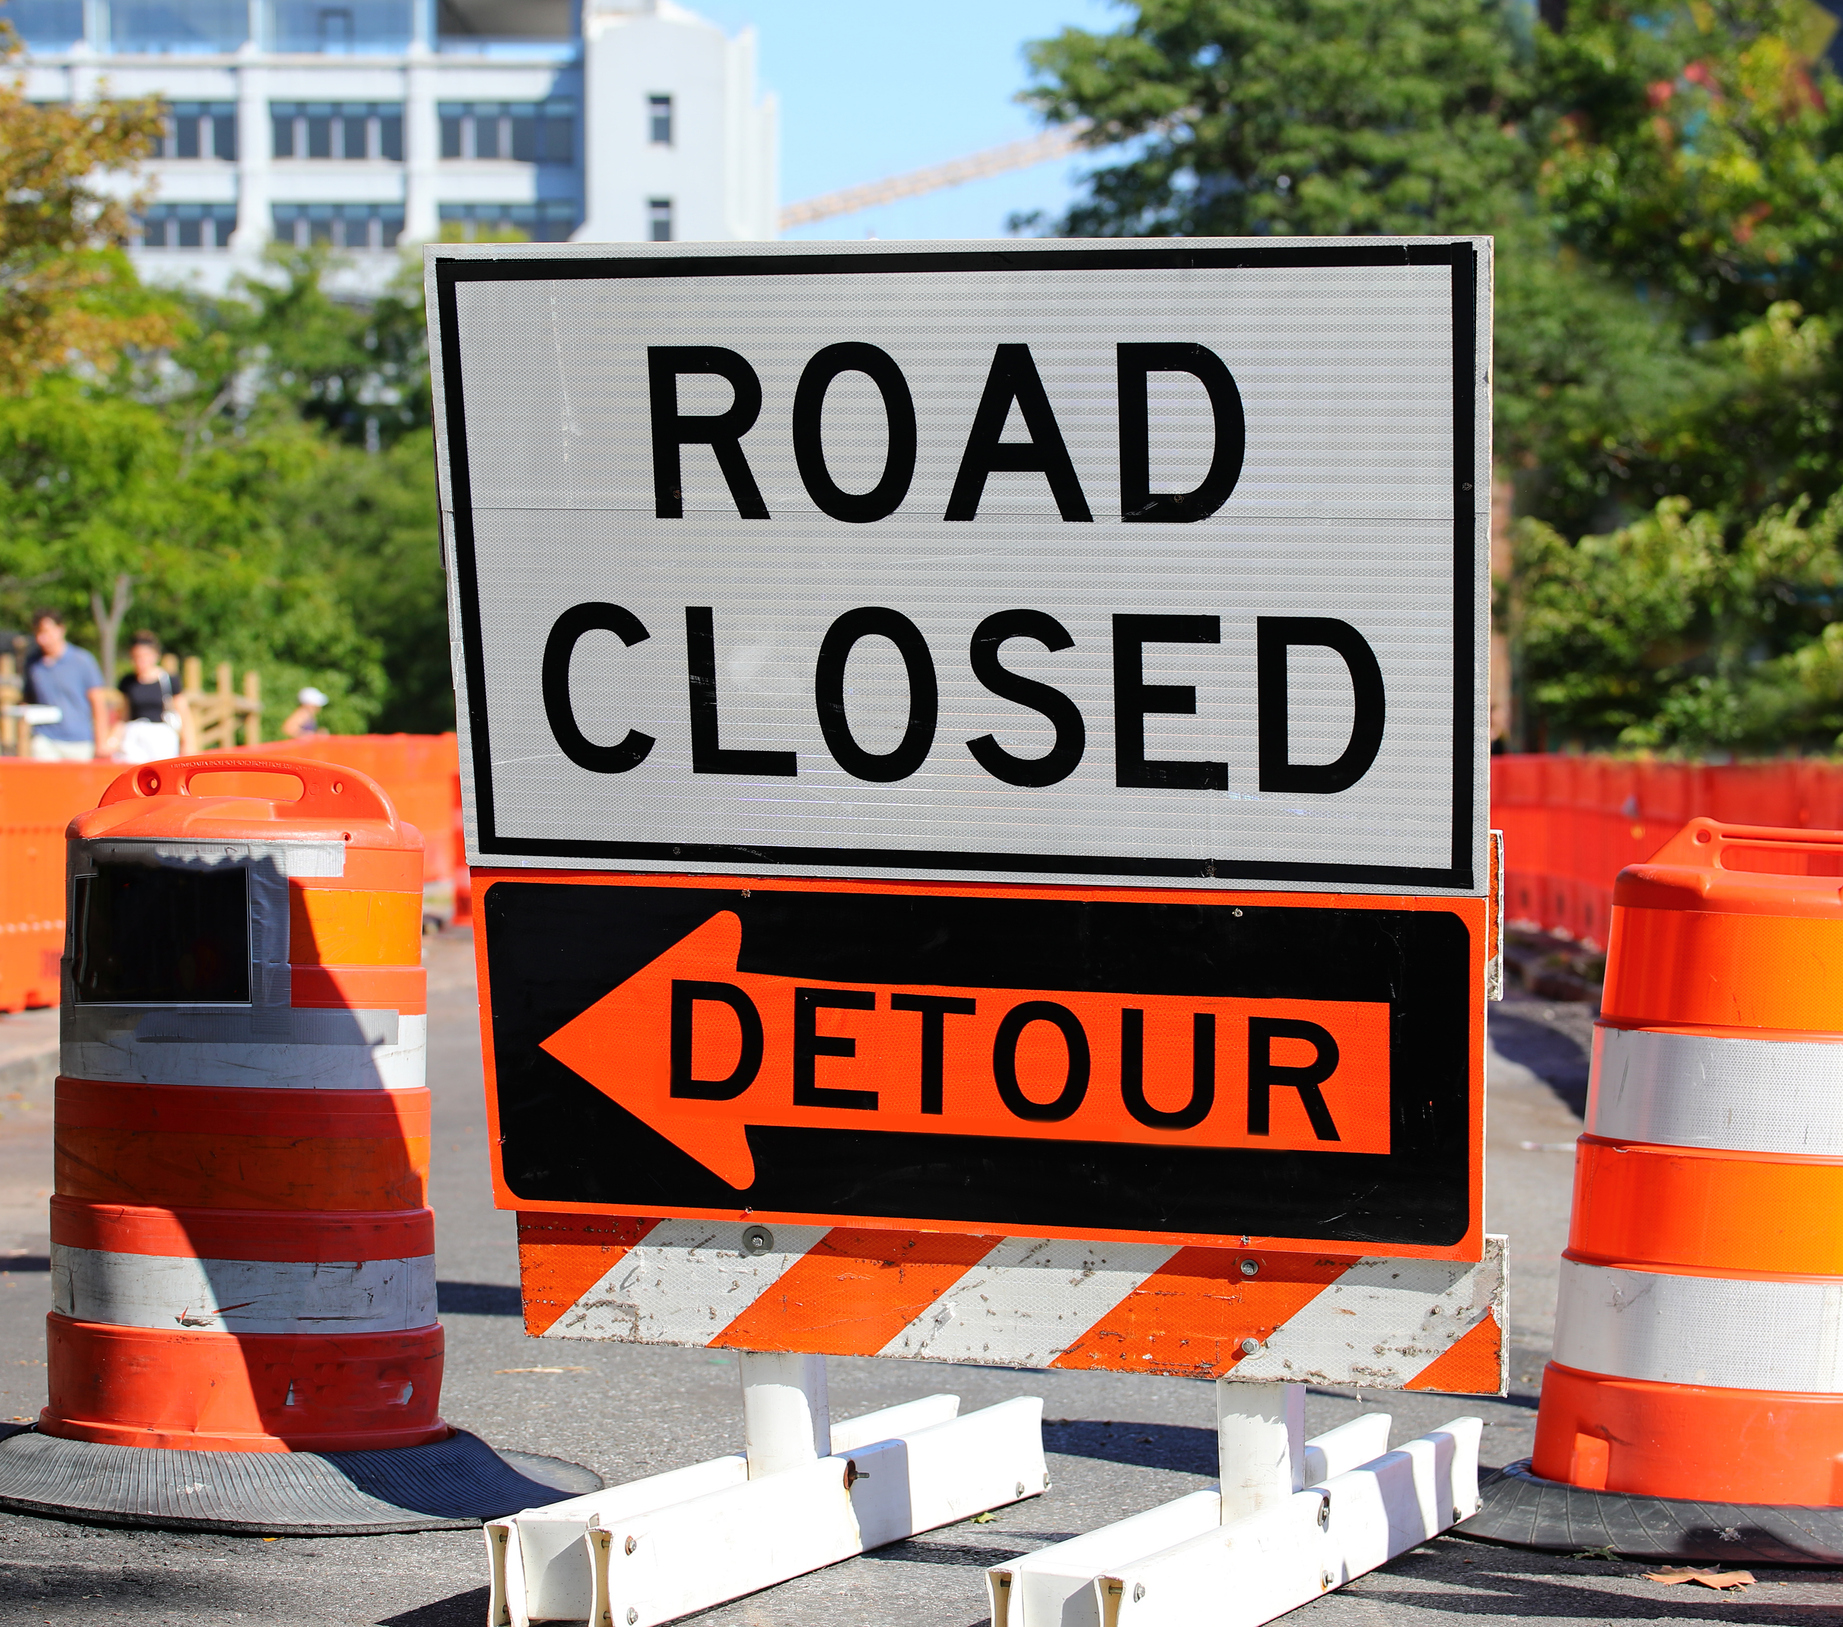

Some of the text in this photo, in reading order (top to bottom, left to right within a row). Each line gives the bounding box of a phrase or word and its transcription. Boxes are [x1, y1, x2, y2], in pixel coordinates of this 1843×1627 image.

[647, 342, 1245, 523] ROAD
[542, 602, 1386, 794] CLOSED
[671, 980, 1341, 1142] DETOUR
